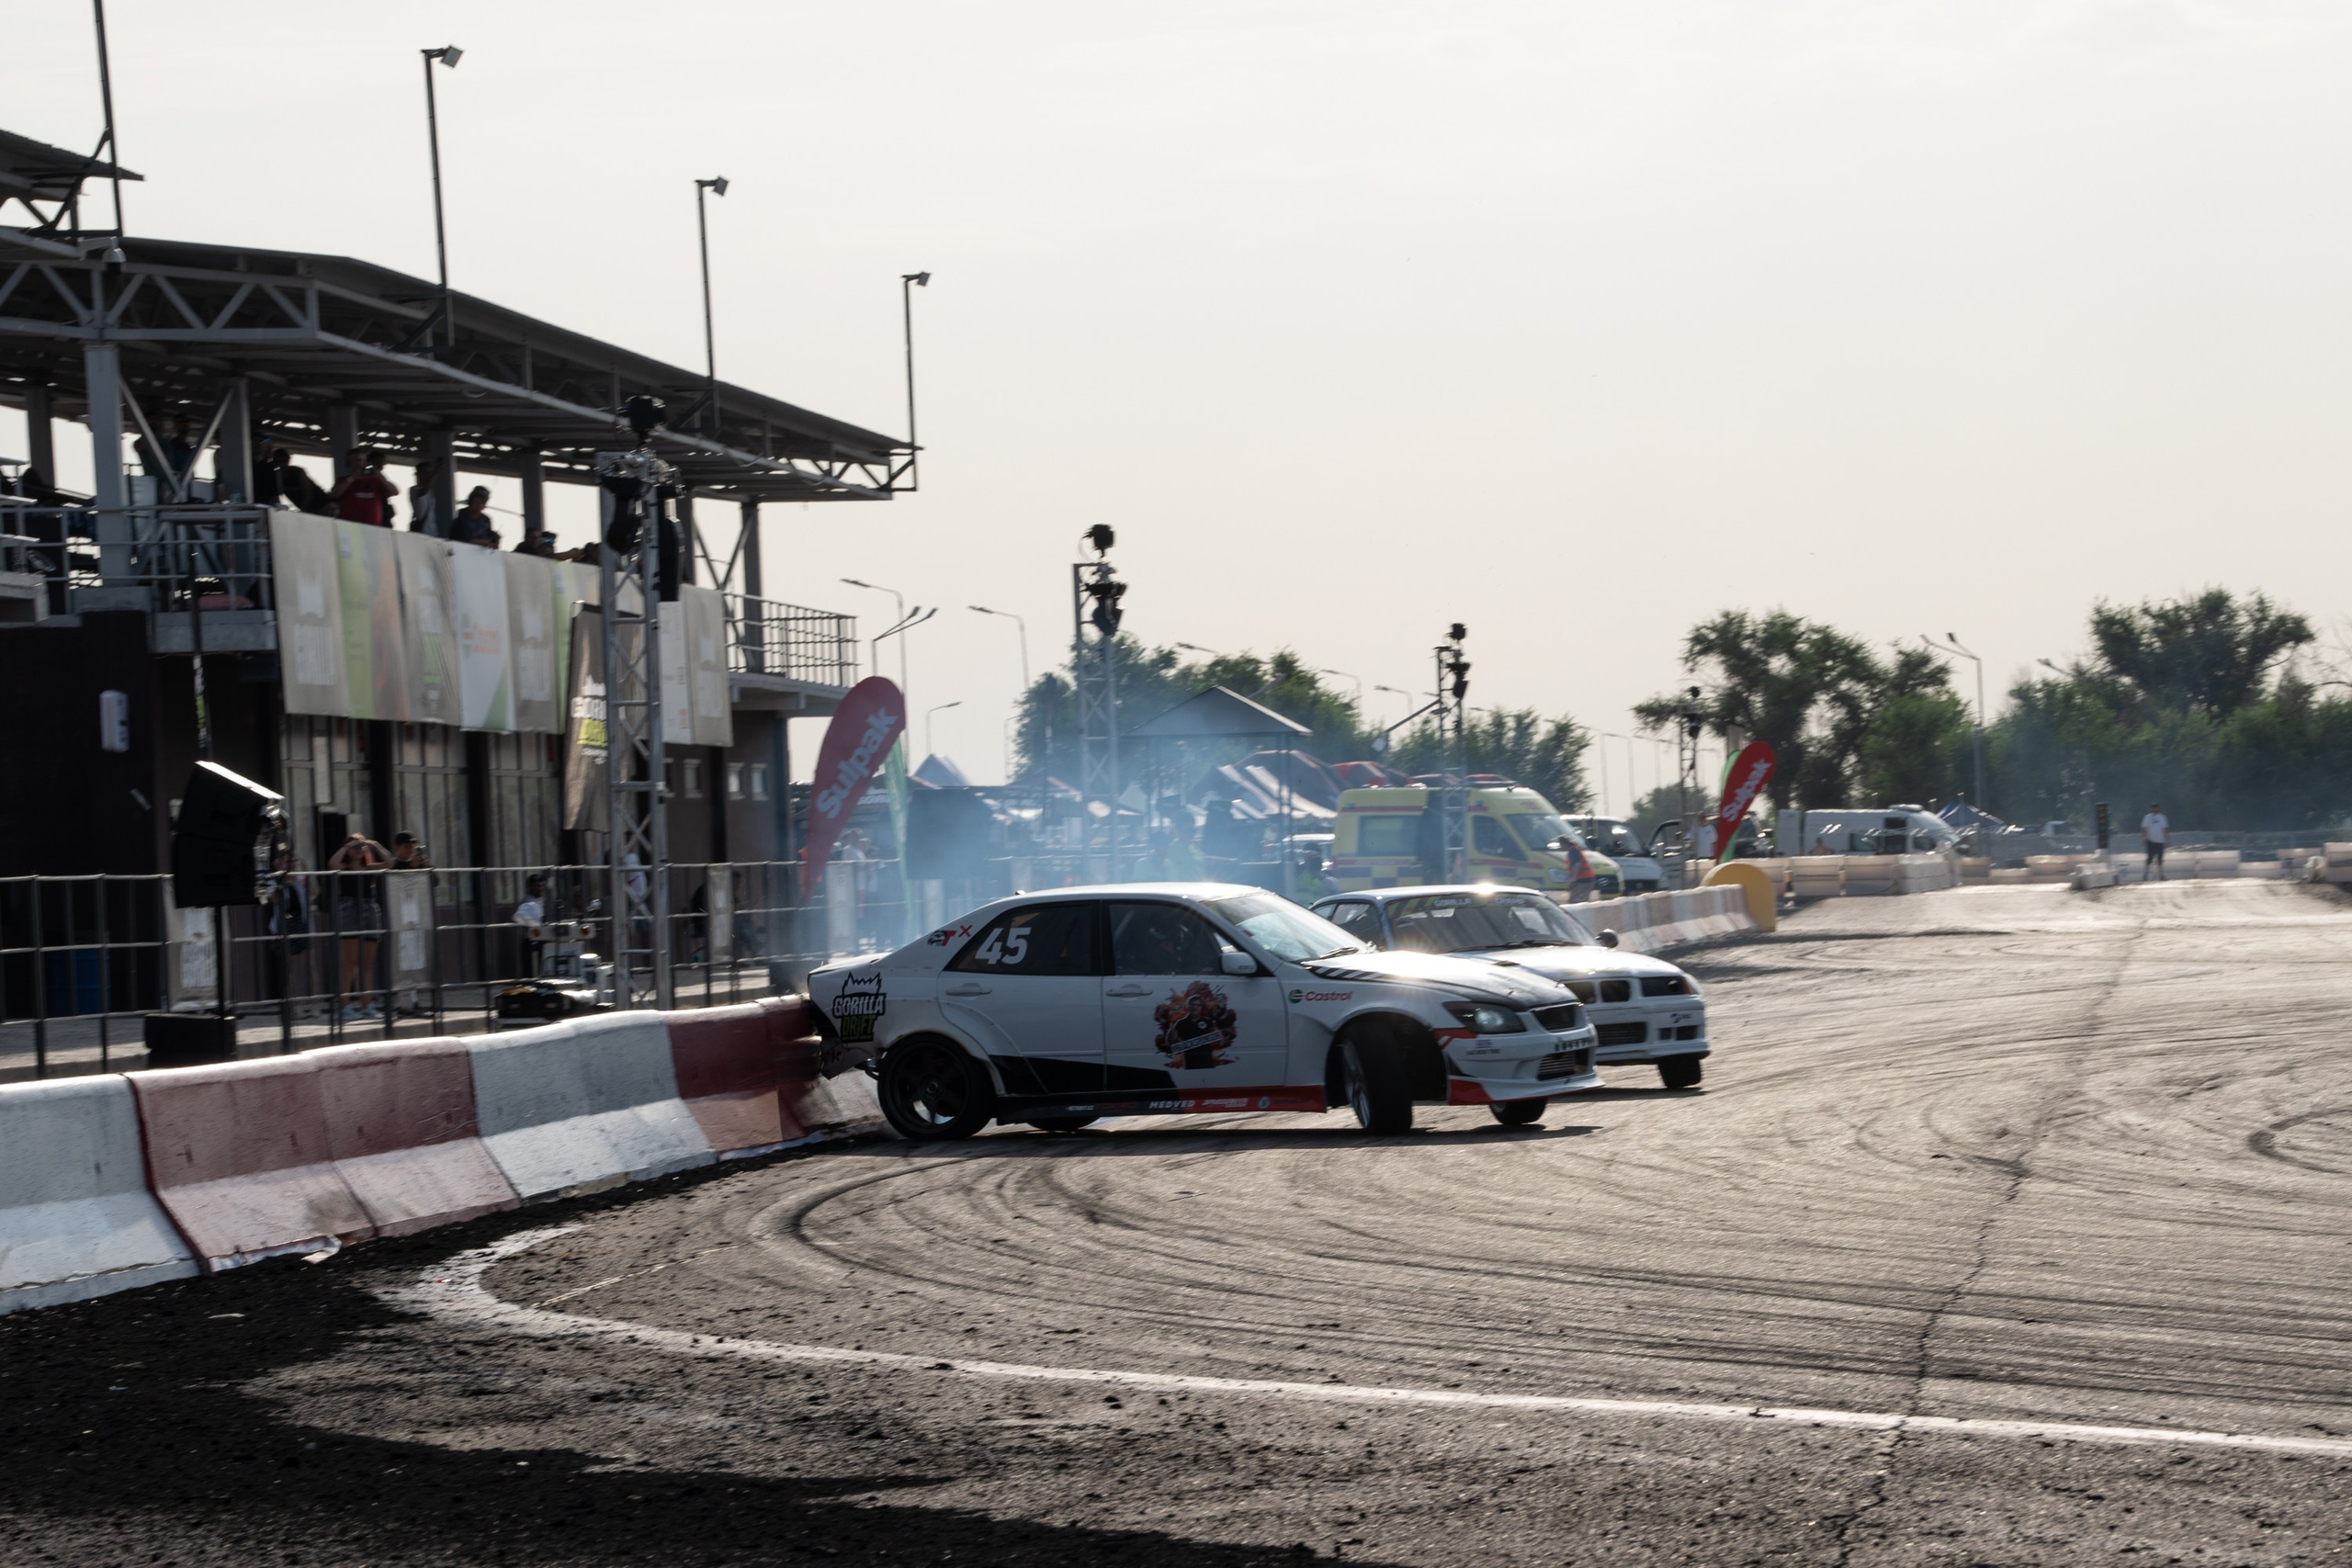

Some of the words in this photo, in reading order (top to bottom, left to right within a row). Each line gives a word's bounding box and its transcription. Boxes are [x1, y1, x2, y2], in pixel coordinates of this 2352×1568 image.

[815, 706, 899, 819] Sulpak
[975, 927, 1032, 964] 45
[834, 995, 885, 1017] GORILLA
[1305, 991, 1353, 1001] Castrol
[1148, 1100, 1195, 1109] MEDVED
